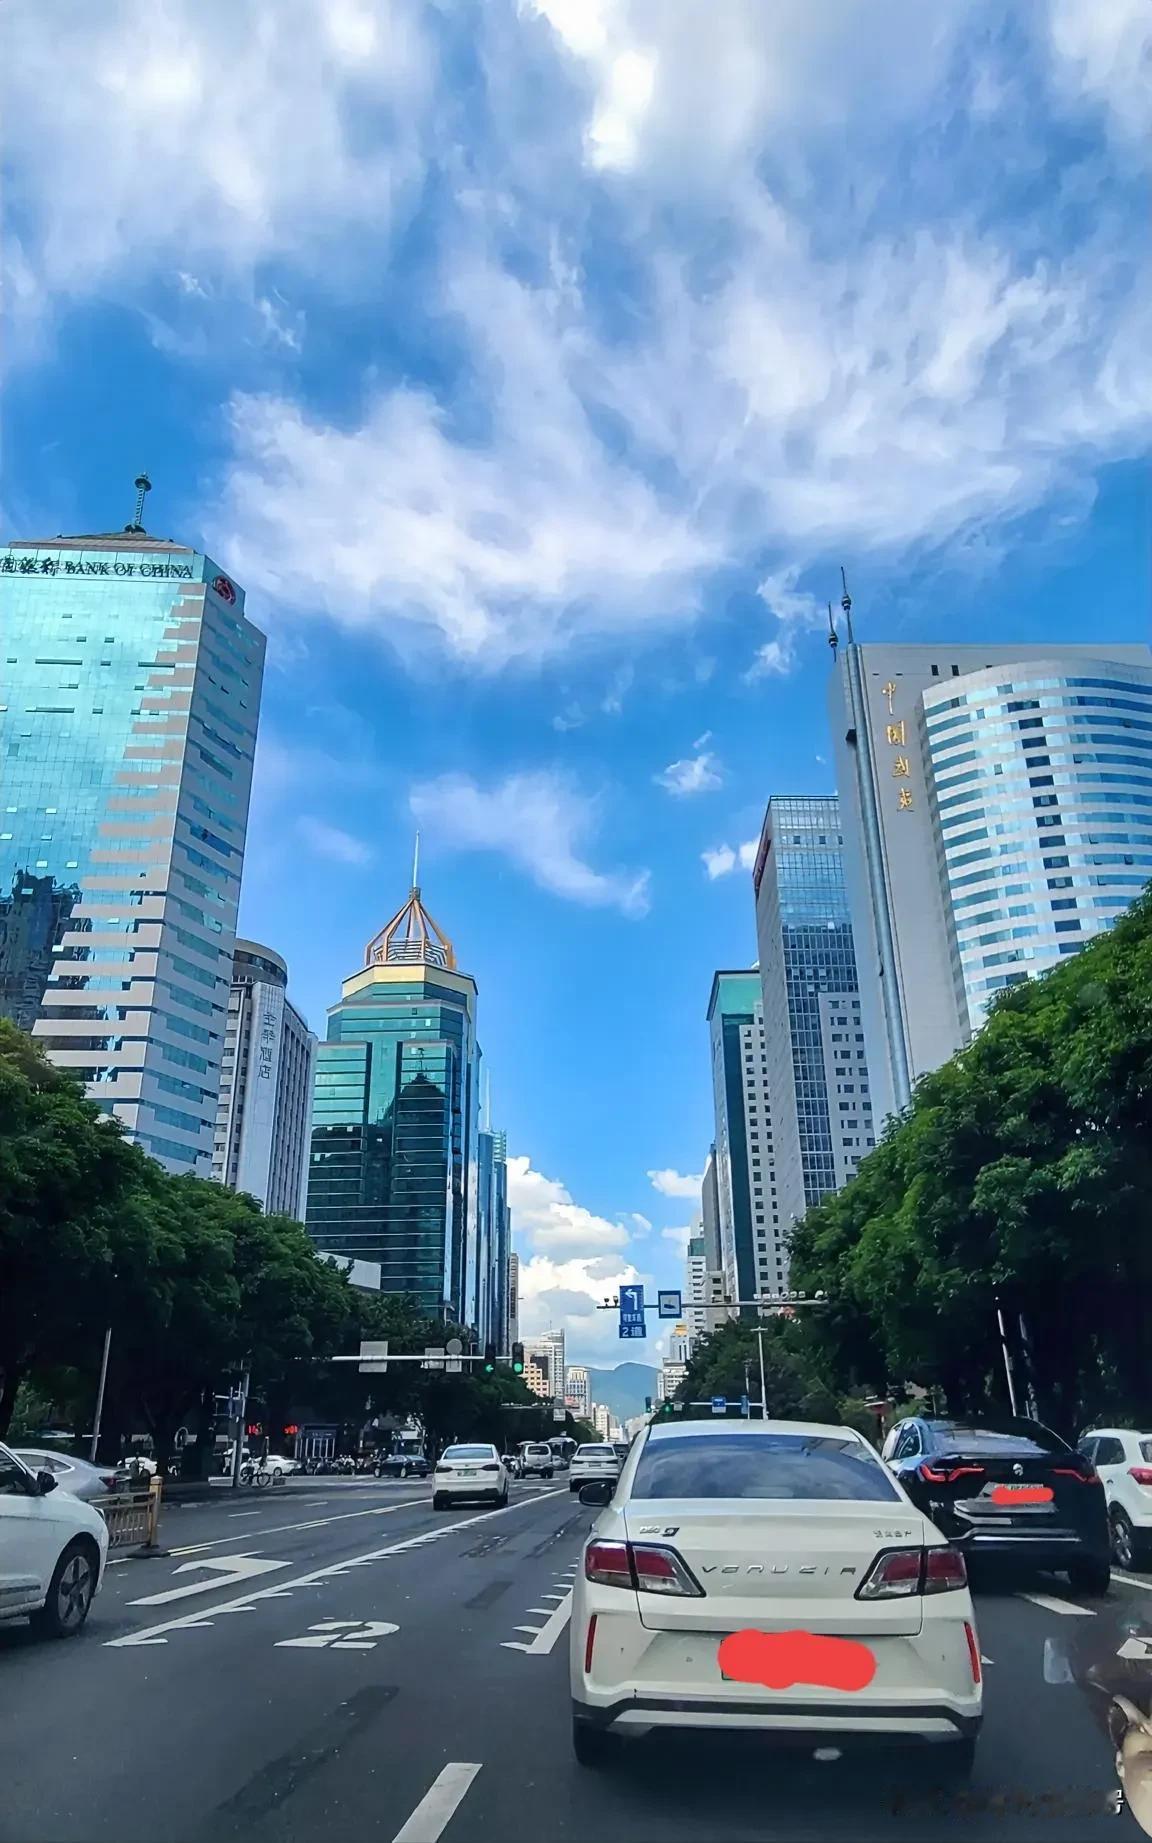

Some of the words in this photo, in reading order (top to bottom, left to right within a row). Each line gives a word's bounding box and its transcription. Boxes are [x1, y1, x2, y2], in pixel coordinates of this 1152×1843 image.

[65, 561, 109, 575] BANK
[114, 563, 135, 576] OF
[140, 564, 193, 579] CHINA
